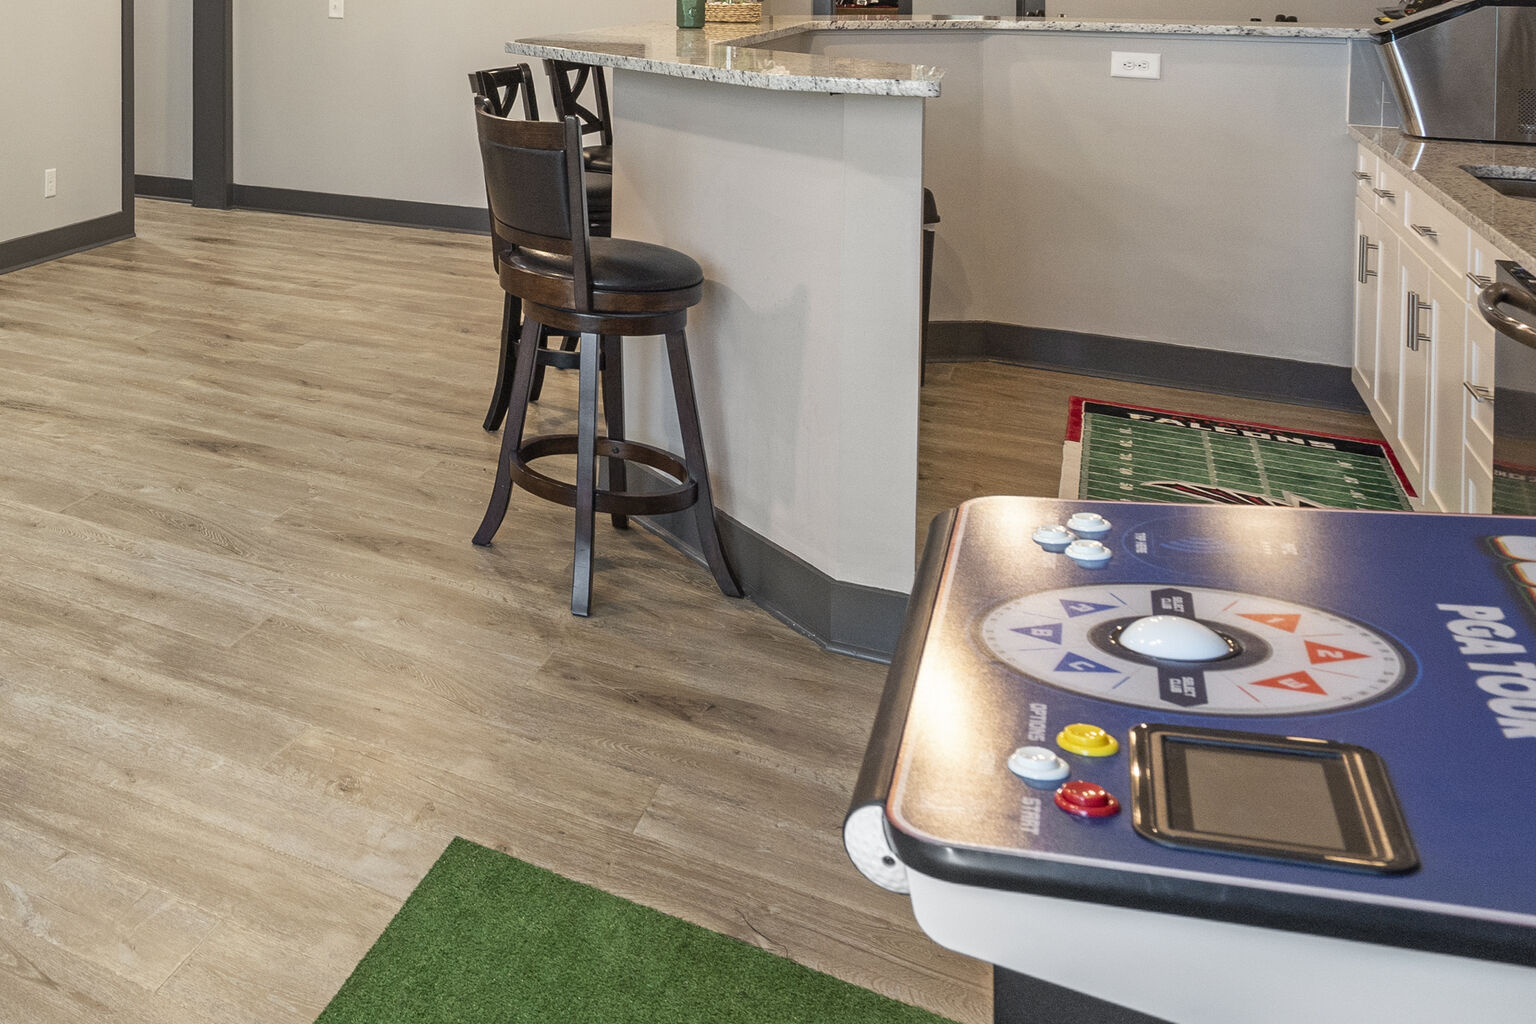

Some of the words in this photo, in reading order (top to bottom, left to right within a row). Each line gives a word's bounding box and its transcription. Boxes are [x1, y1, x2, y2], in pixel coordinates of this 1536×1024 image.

[1126, 412, 1337, 450] FALCONS
[1029, 628, 1054, 637] B
[1435, 603, 1528, 655] PGA
[1317, 649, 1345, 659] 2
[1169, 678, 1183, 693] CLUB
[1182, 676, 1197, 698] SELECT
[1028, 703, 1048, 742] OPTIONS
[1021, 796, 1042, 836] START
